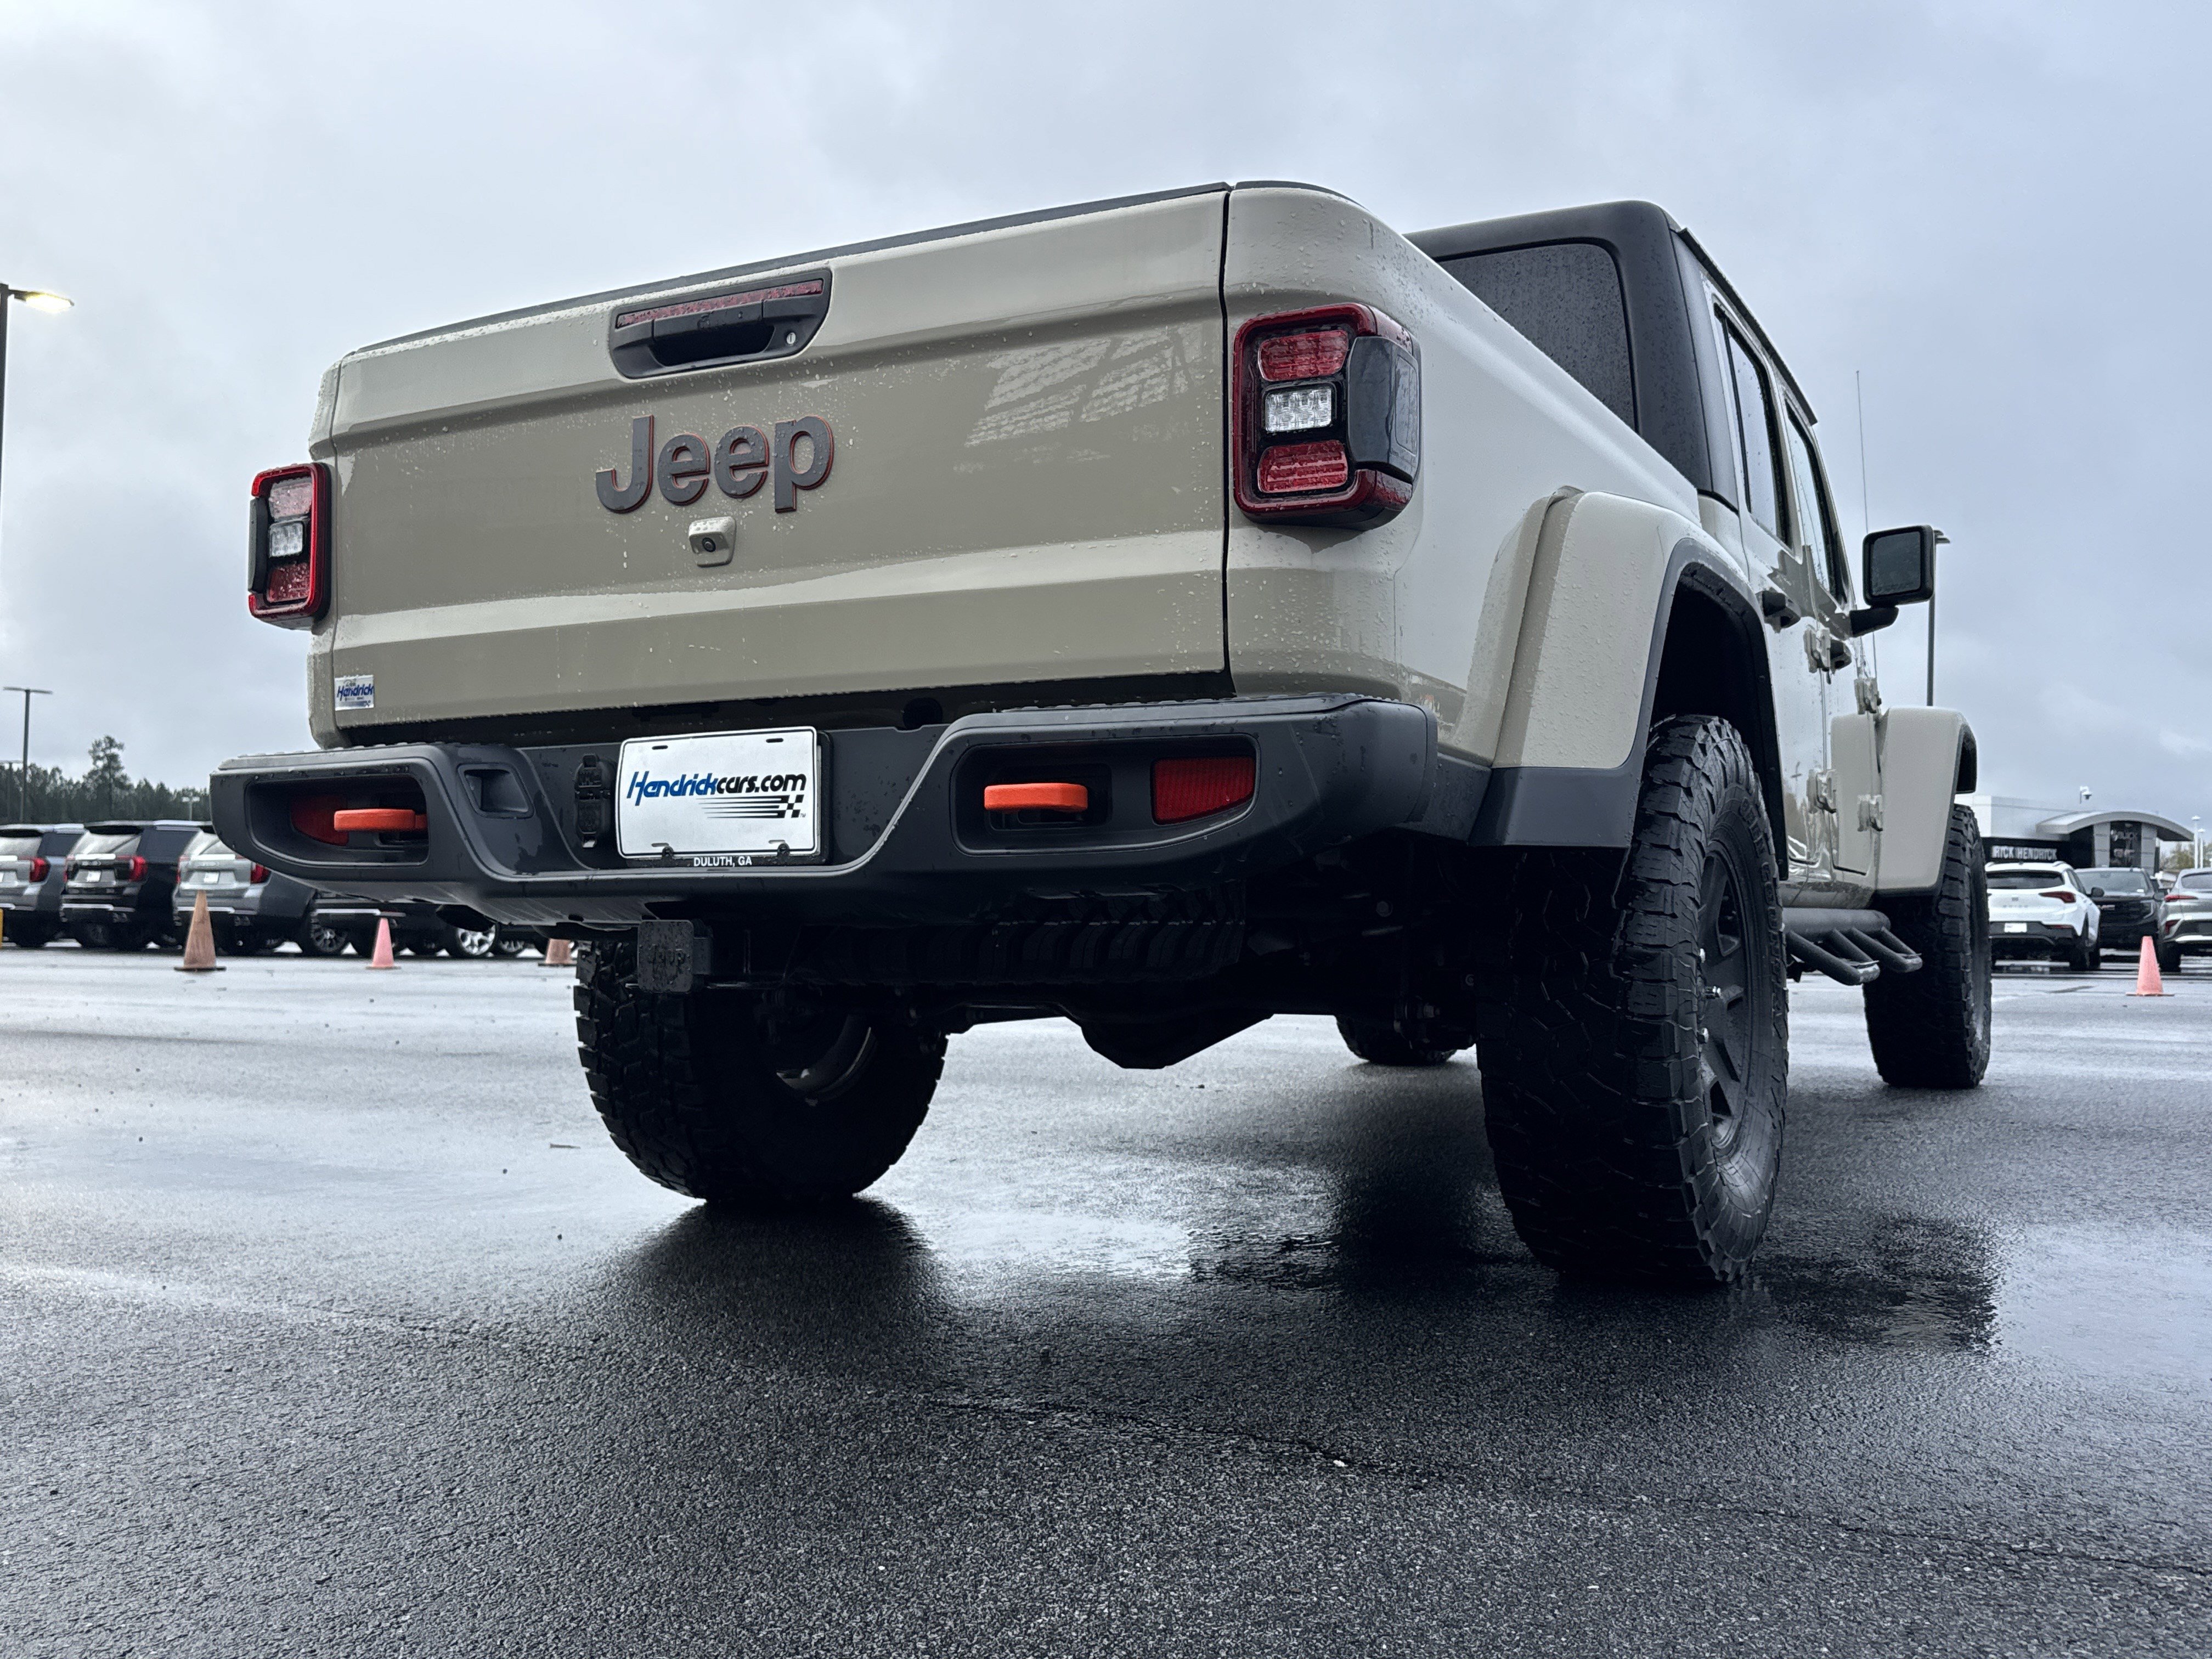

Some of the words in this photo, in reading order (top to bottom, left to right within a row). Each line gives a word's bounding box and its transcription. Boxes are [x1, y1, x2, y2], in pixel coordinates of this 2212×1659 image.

[596, 415, 834, 514] Jeep
[336, 684, 375, 701] Hendrick
[627, 771, 806, 806] Hendrickcars.com
[693, 856, 735, 867] DULUTH,
[738, 856, 752, 865] GA
